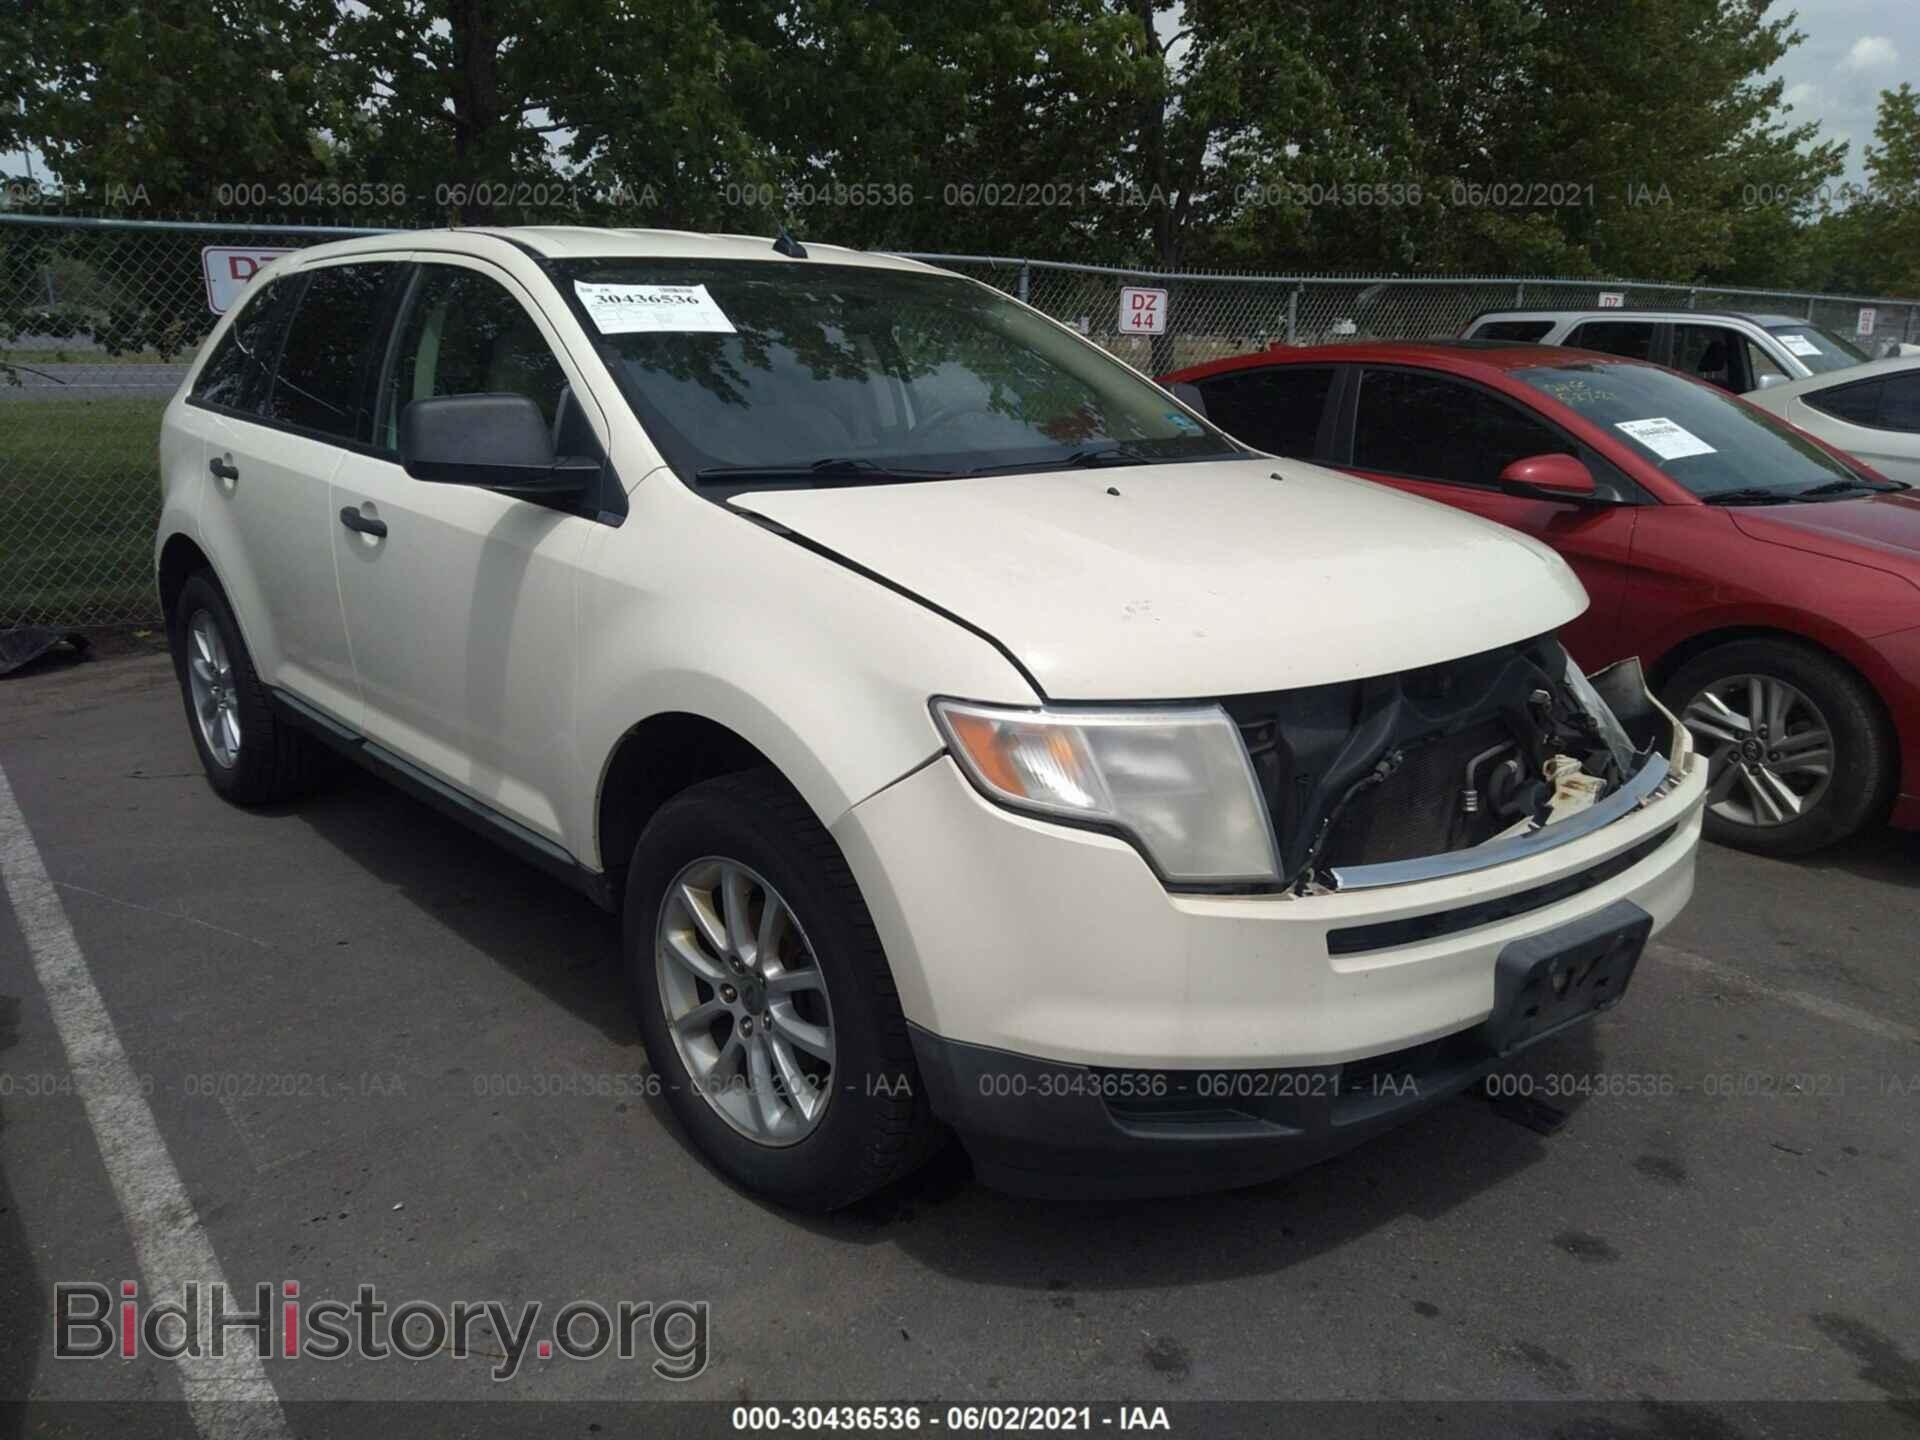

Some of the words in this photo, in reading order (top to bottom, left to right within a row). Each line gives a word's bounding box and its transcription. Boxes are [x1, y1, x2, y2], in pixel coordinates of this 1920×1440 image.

[595, 294, 700, 304] 30436536
[1132, 294, 1157, 311] DZ
[1132, 312, 1154, 328] 44
